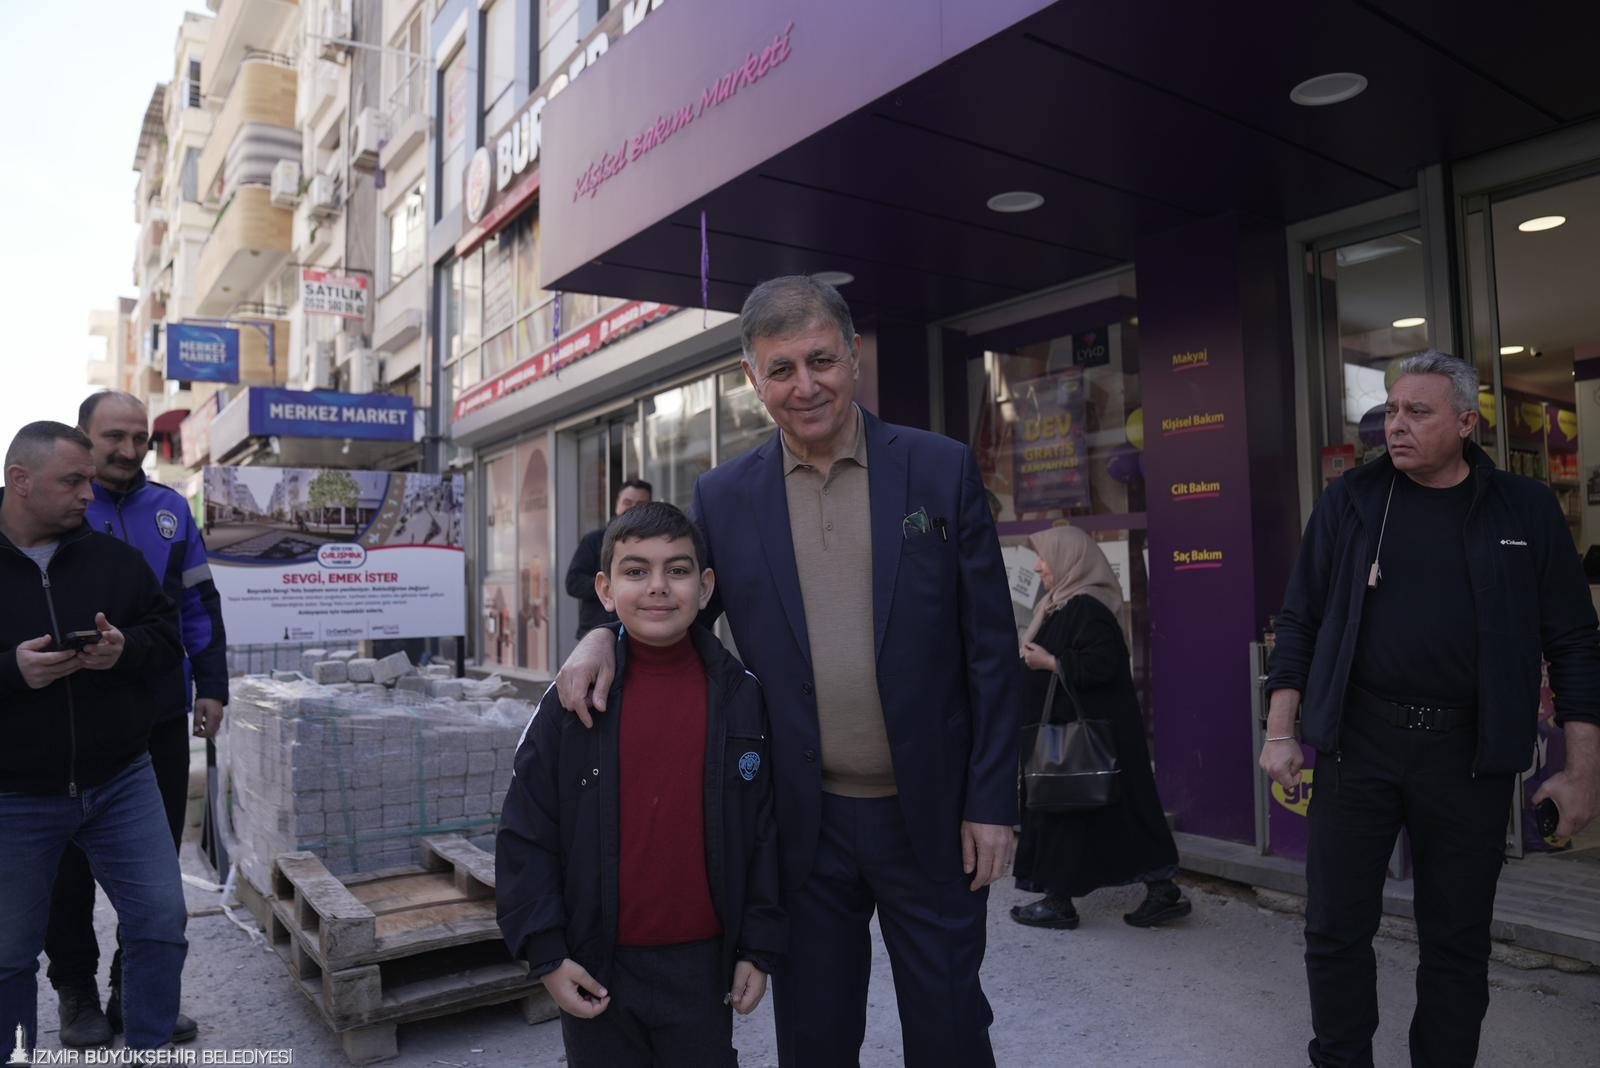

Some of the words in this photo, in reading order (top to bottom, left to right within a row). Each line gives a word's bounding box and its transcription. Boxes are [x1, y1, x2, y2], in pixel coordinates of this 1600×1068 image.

[573, 139, 628, 203] Kişisel
[631, 103, 694, 162] Bakım
[697, 19, 794, 118] Marketi
[305, 284, 363, 302] SATILIK
[179, 340, 226, 353] MERKEZ
[179, 352, 227, 364] MARKET
[1172, 348, 1207, 366] Makyaj
[269, 402, 338, 423] MERKEZ
[341, 406, 408, 426] MARKET
[1162, 415, 1192, 431] Kişisel
[1193, 412, 1224, 426] Bakım
[1024, 411, 1073, 442] DEV
[1171, 482, 1188, 495] Cilt
[1189, 481, 1220, 493] Bakım
[1173, 550, 1190, 563] Saç
[1191, 548, 1222, 561] Bakım
[282, 571, 325, 585] SEVGİ,
[328, 572, 362, 583] EMEK
[365, 570, 399, 583] İSTER
